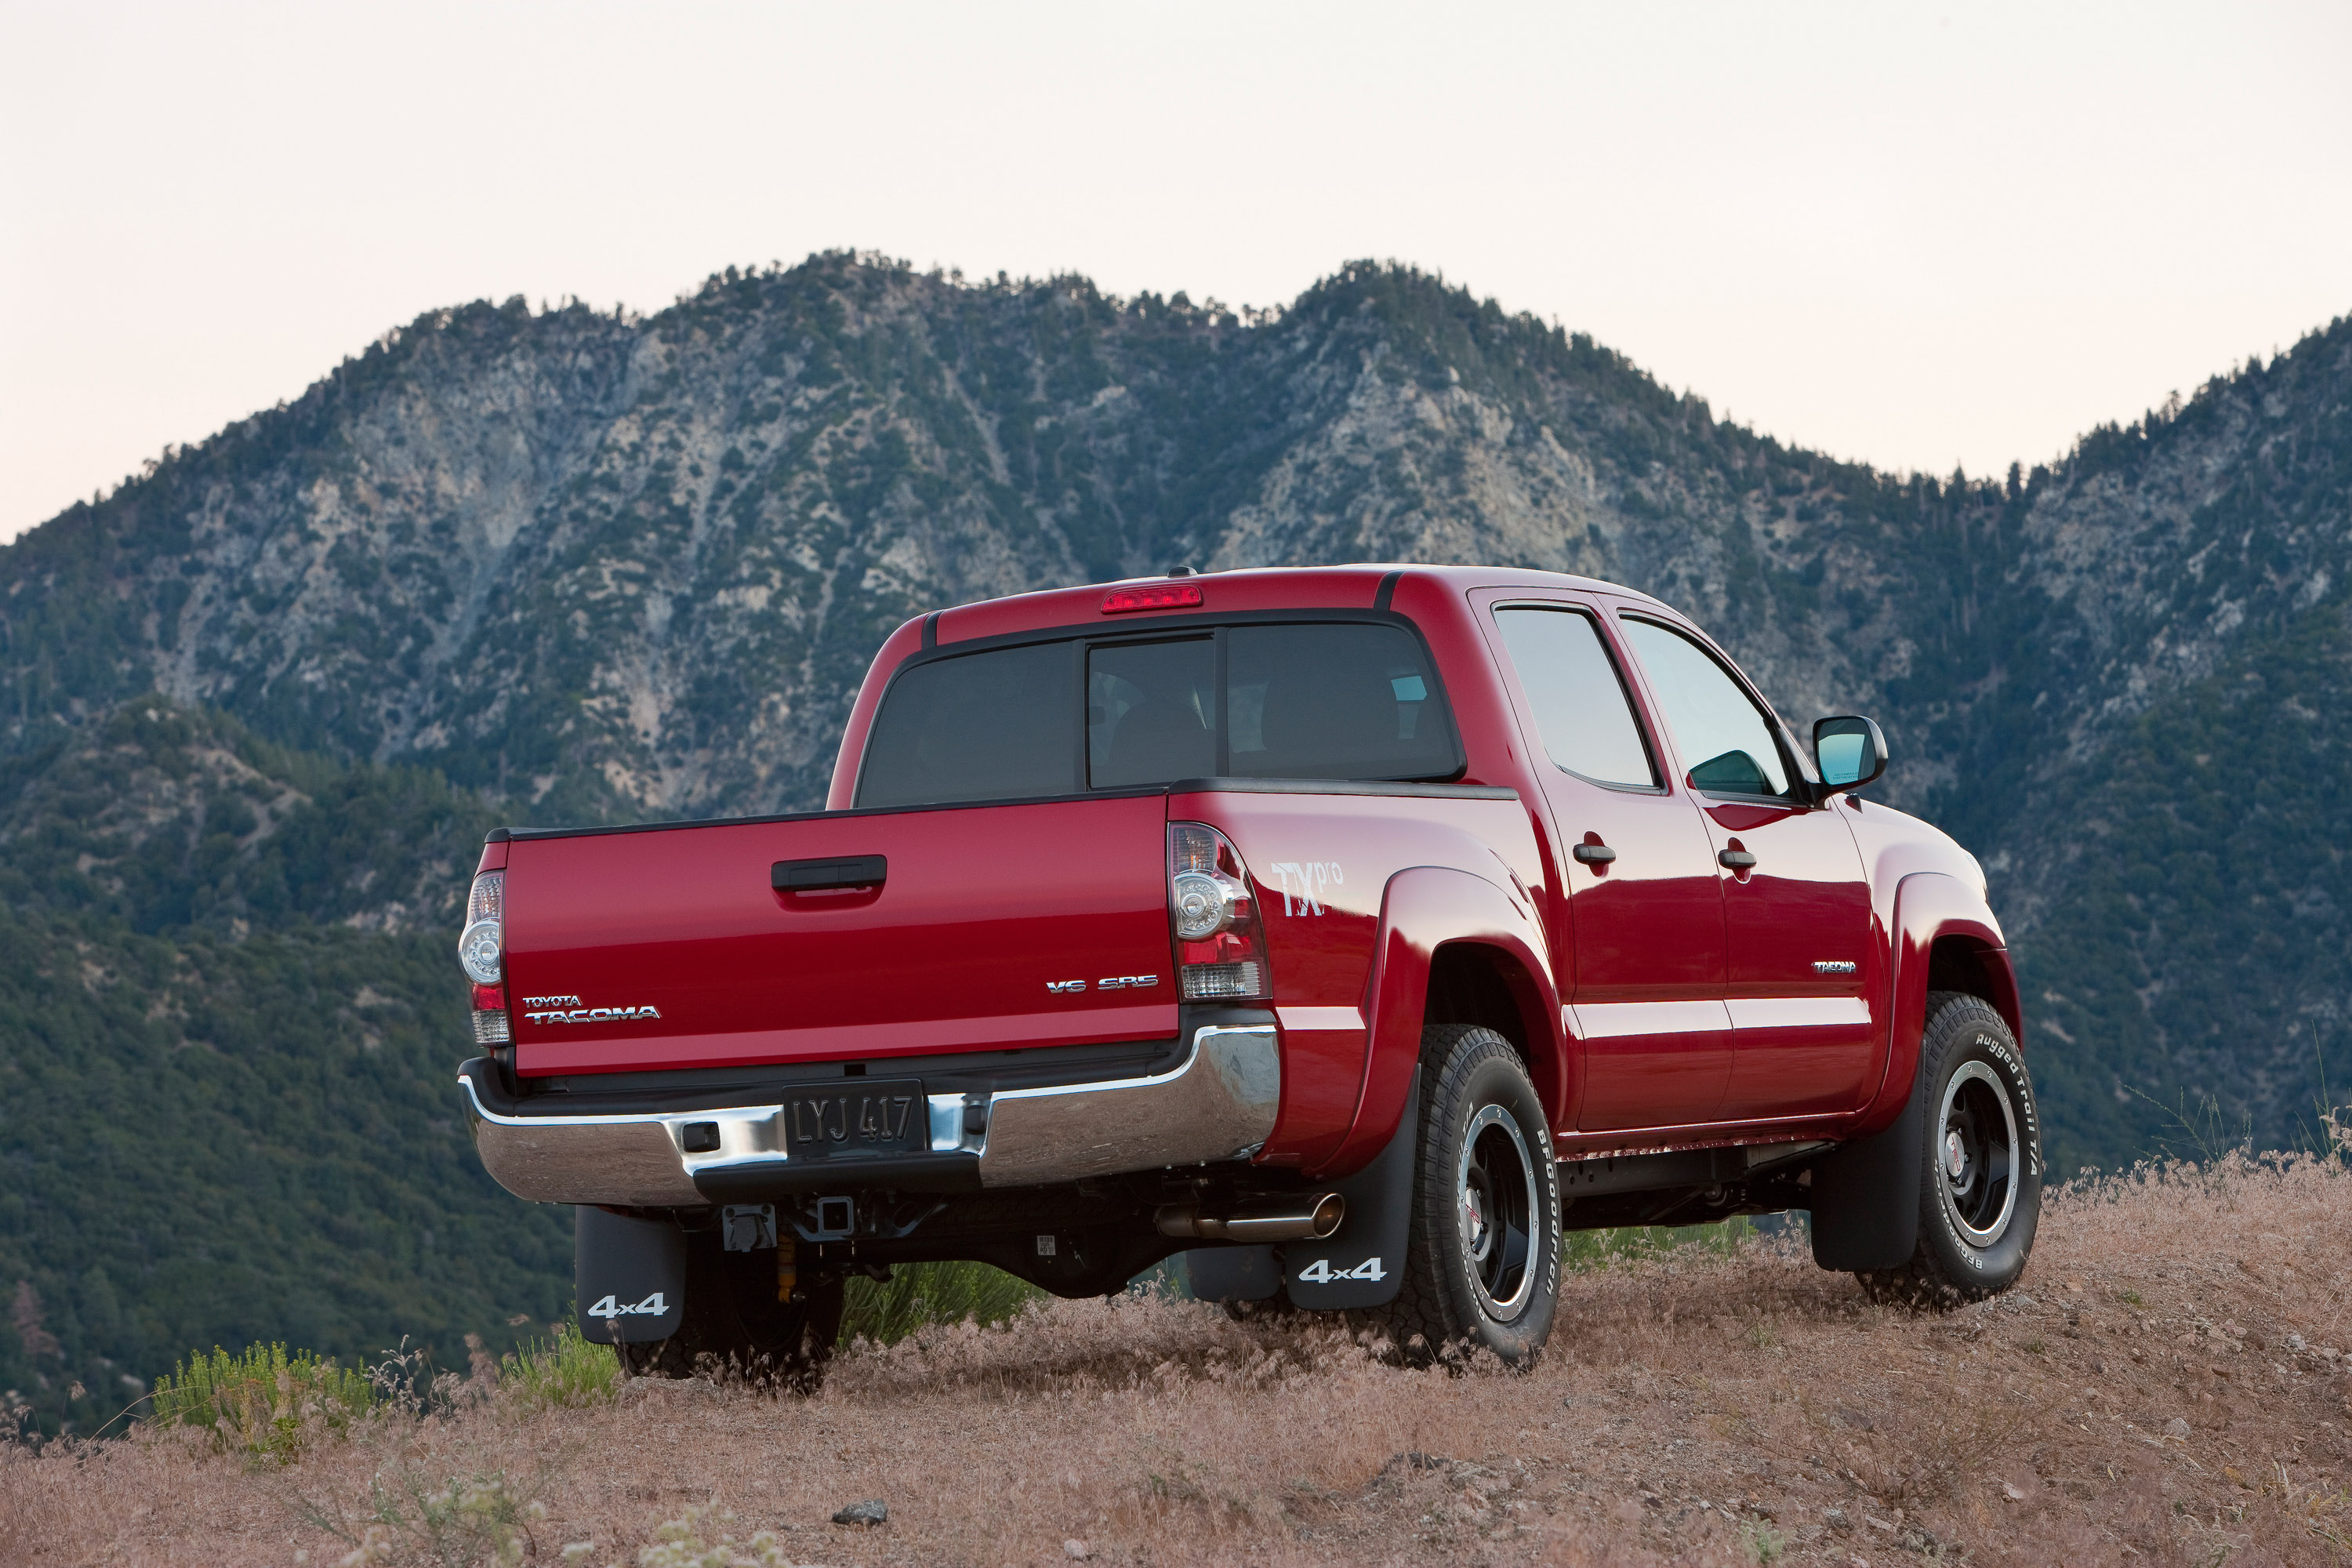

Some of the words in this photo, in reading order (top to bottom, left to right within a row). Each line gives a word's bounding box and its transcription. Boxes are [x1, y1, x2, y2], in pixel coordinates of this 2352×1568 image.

[1047, 980, 1087, 993] V6
[1098, 975, 1159, 989] SR5
[523, 995, 583, 1007] TOYOTA
[524, 1005, 662, 1025] TACOMA
[2016, 1076, 2035, 1131] Trail
[793, 1098, 848, 1144] LYJ
[859, 1097, 912, 1142] 417
[1951, 1136, 1961, 1171] TRD
[1466, 1203, 1480, 1224] TRD
[1537, 1129, 1559, 1295] BFGoodrich
[1934, 1159, 1983, 1269] BFGoodrich
[1298, 1257, 1387, 1283] 4x4
[587, 1292, 670, 1318] 4x4
